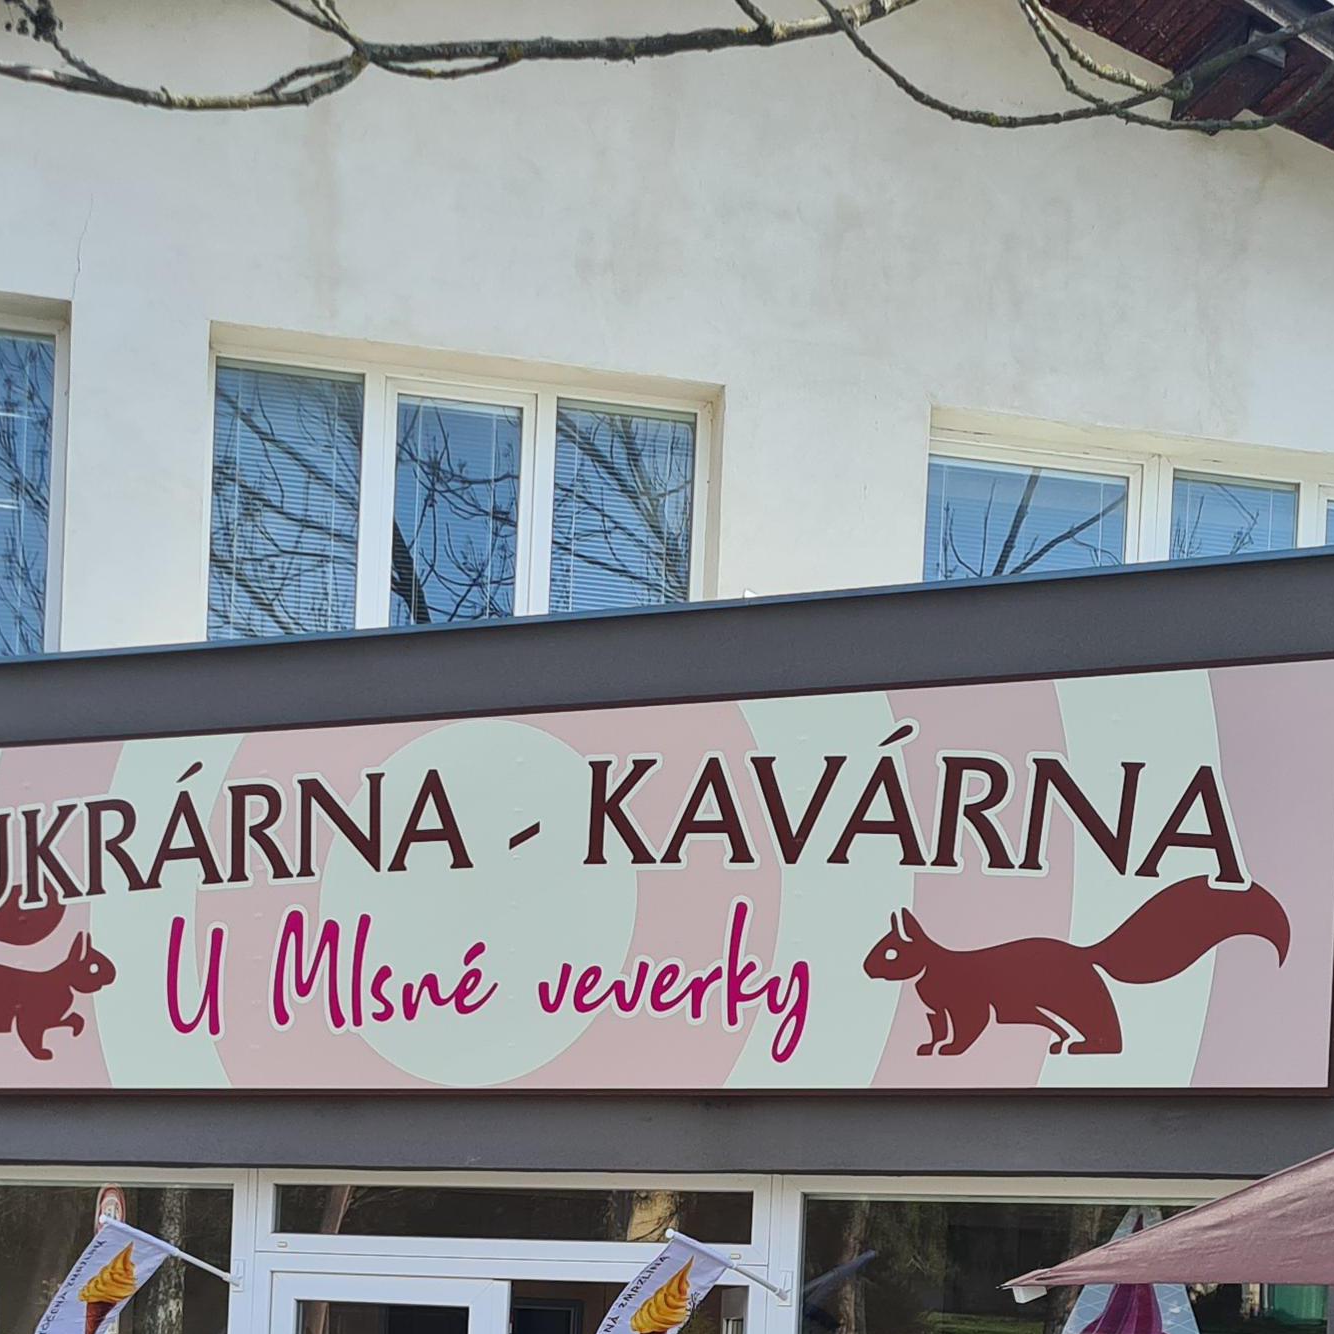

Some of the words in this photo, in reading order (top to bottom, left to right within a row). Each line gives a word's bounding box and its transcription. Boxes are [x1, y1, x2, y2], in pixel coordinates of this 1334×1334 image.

[508, 821, 541, 850] -
[583, 724, 1246, 884] KAVÁRNA
[166, 916, 222, 1035] U
[273, 909, 498, 1031] Mlsné
[538, 902, 809, 1063] veverky
